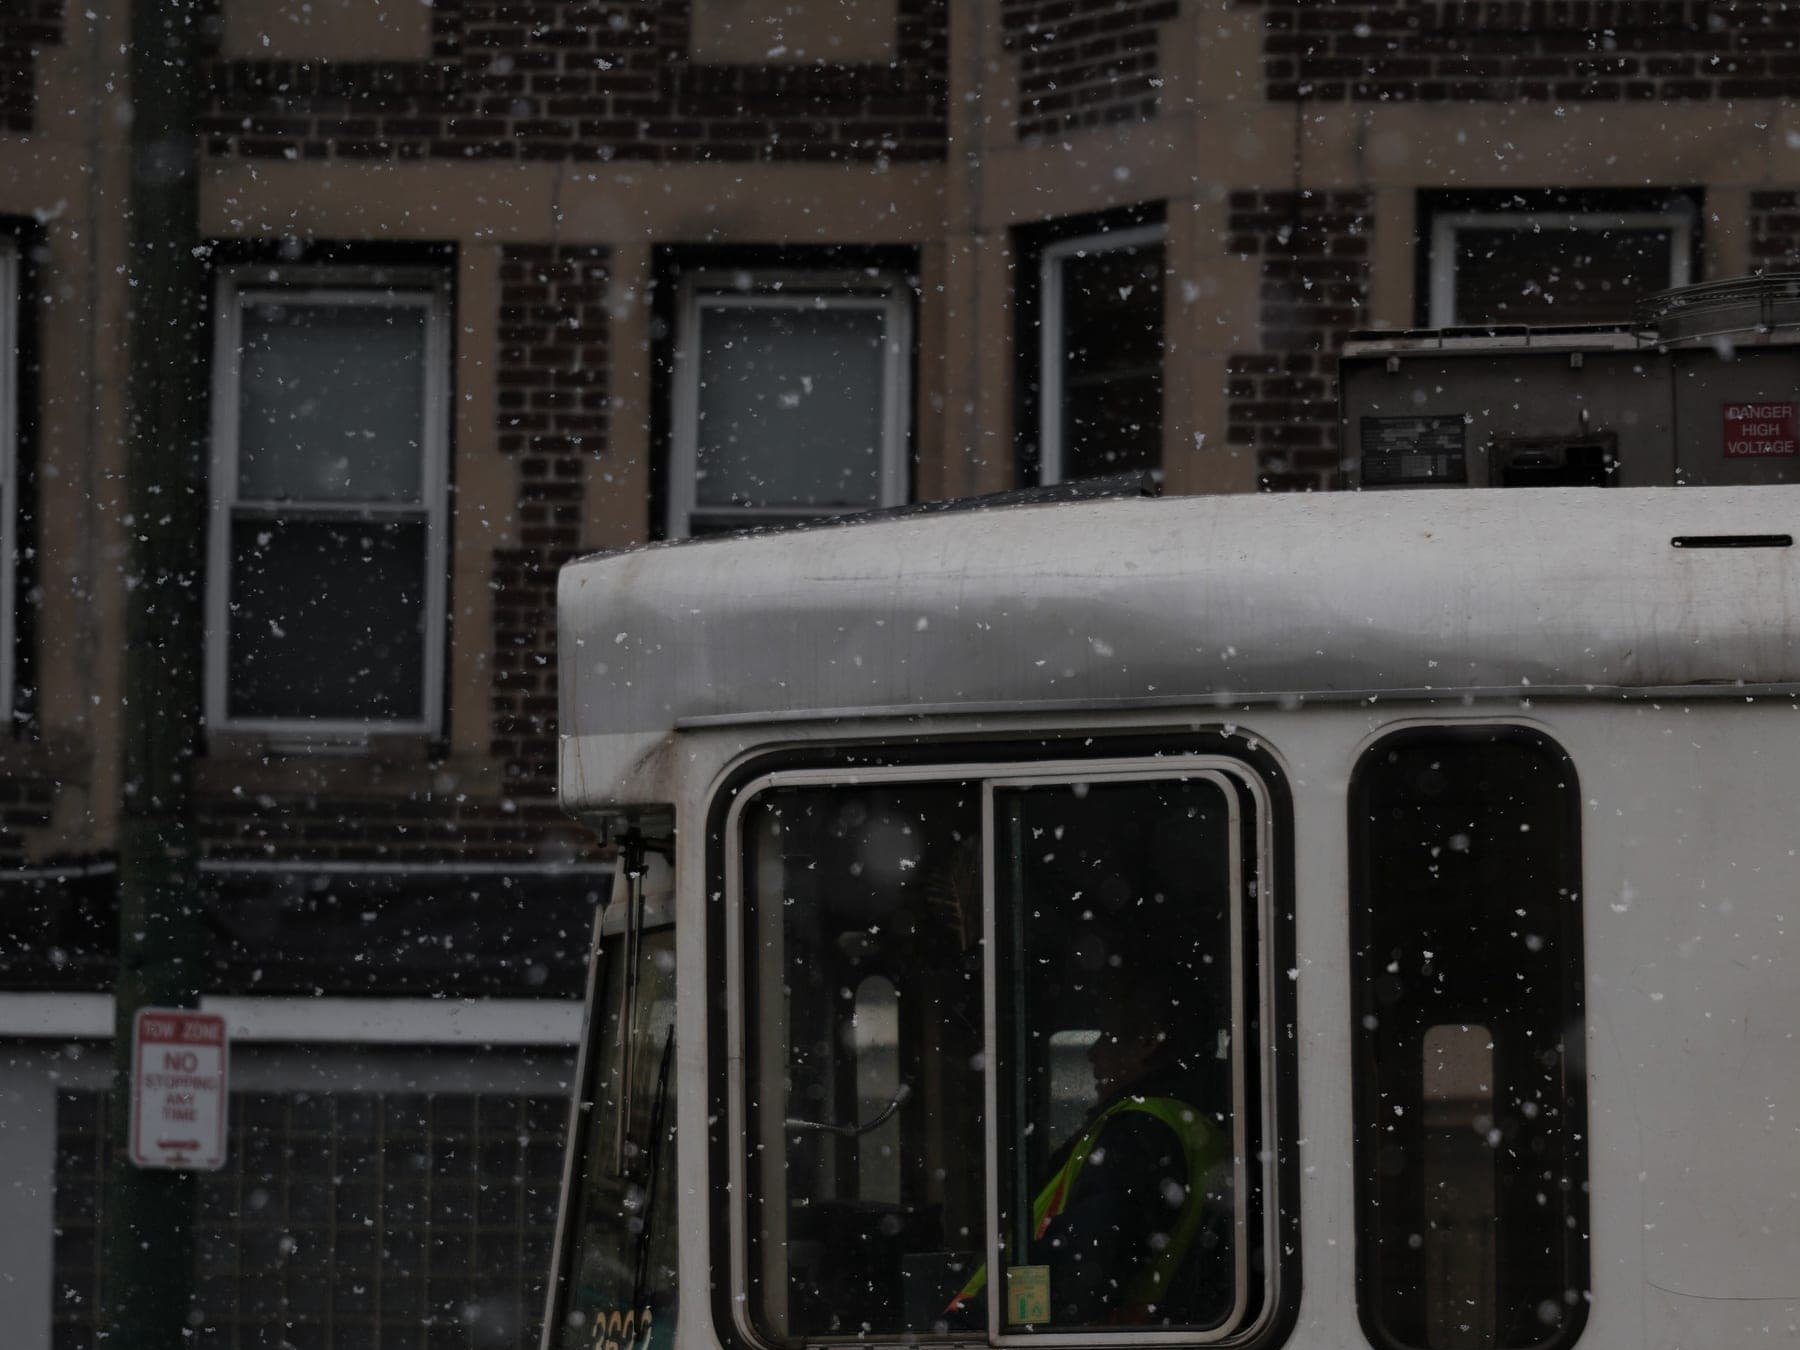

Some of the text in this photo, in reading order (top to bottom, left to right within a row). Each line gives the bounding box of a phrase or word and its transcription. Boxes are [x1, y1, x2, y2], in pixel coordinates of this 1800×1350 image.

[1728, 406, 1792, 419] DANGER
[1742, 423, 1780, 436] HIGH
[1728, 440, 1794, 454] VOLTAGE
[144, 1020, 219, 1041] TOW ZONE
[163, 1051, 198, 1073] NO
[144, 1075, 217, 1090] STOPPING
[166, 1092, 194, 1105] ANY
[162, 1107, 198, 1121] TIME
